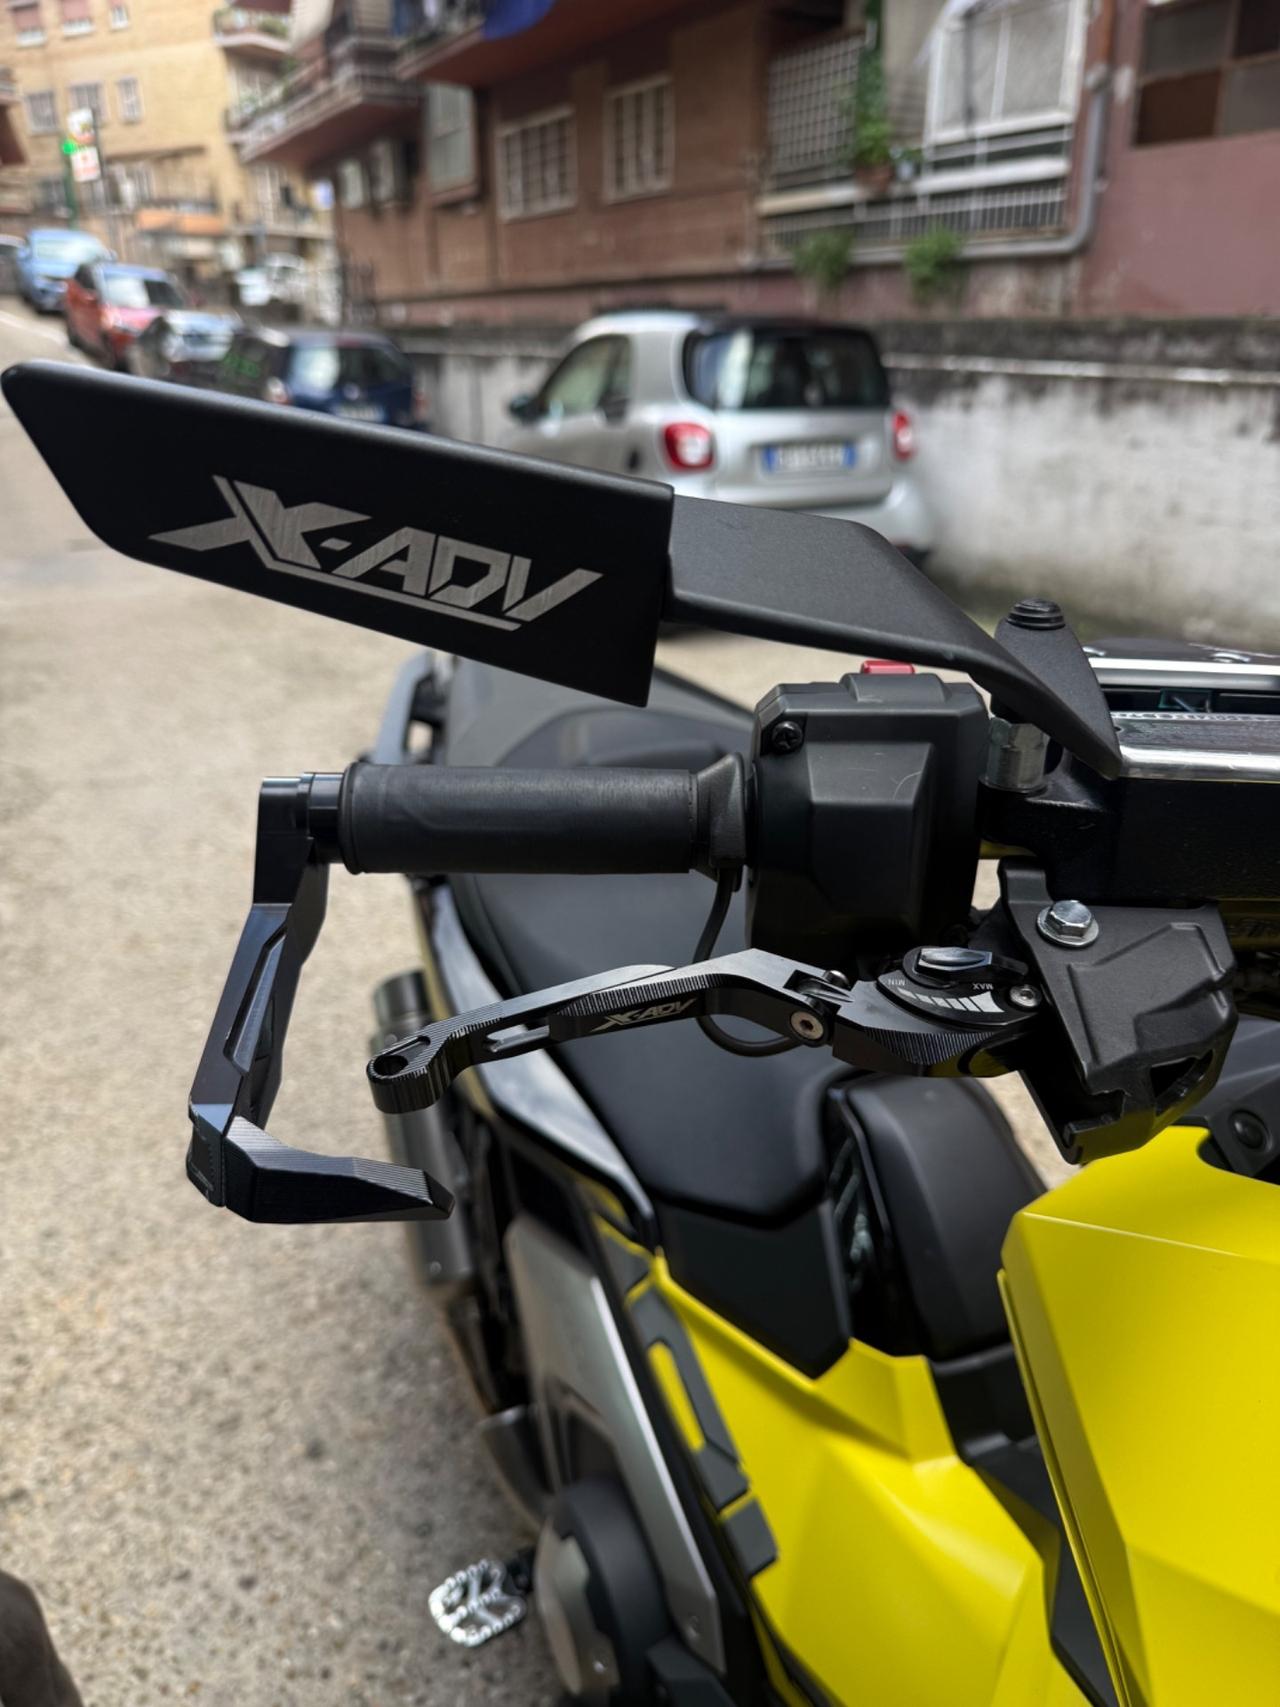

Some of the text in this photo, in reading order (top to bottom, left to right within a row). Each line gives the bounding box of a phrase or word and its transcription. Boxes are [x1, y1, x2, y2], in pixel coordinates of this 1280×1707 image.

[148, 475, 604, 631] X-ADV
[887, 978, 906, 986] MIN
[591, 998, 698, 1033] X-ADV
